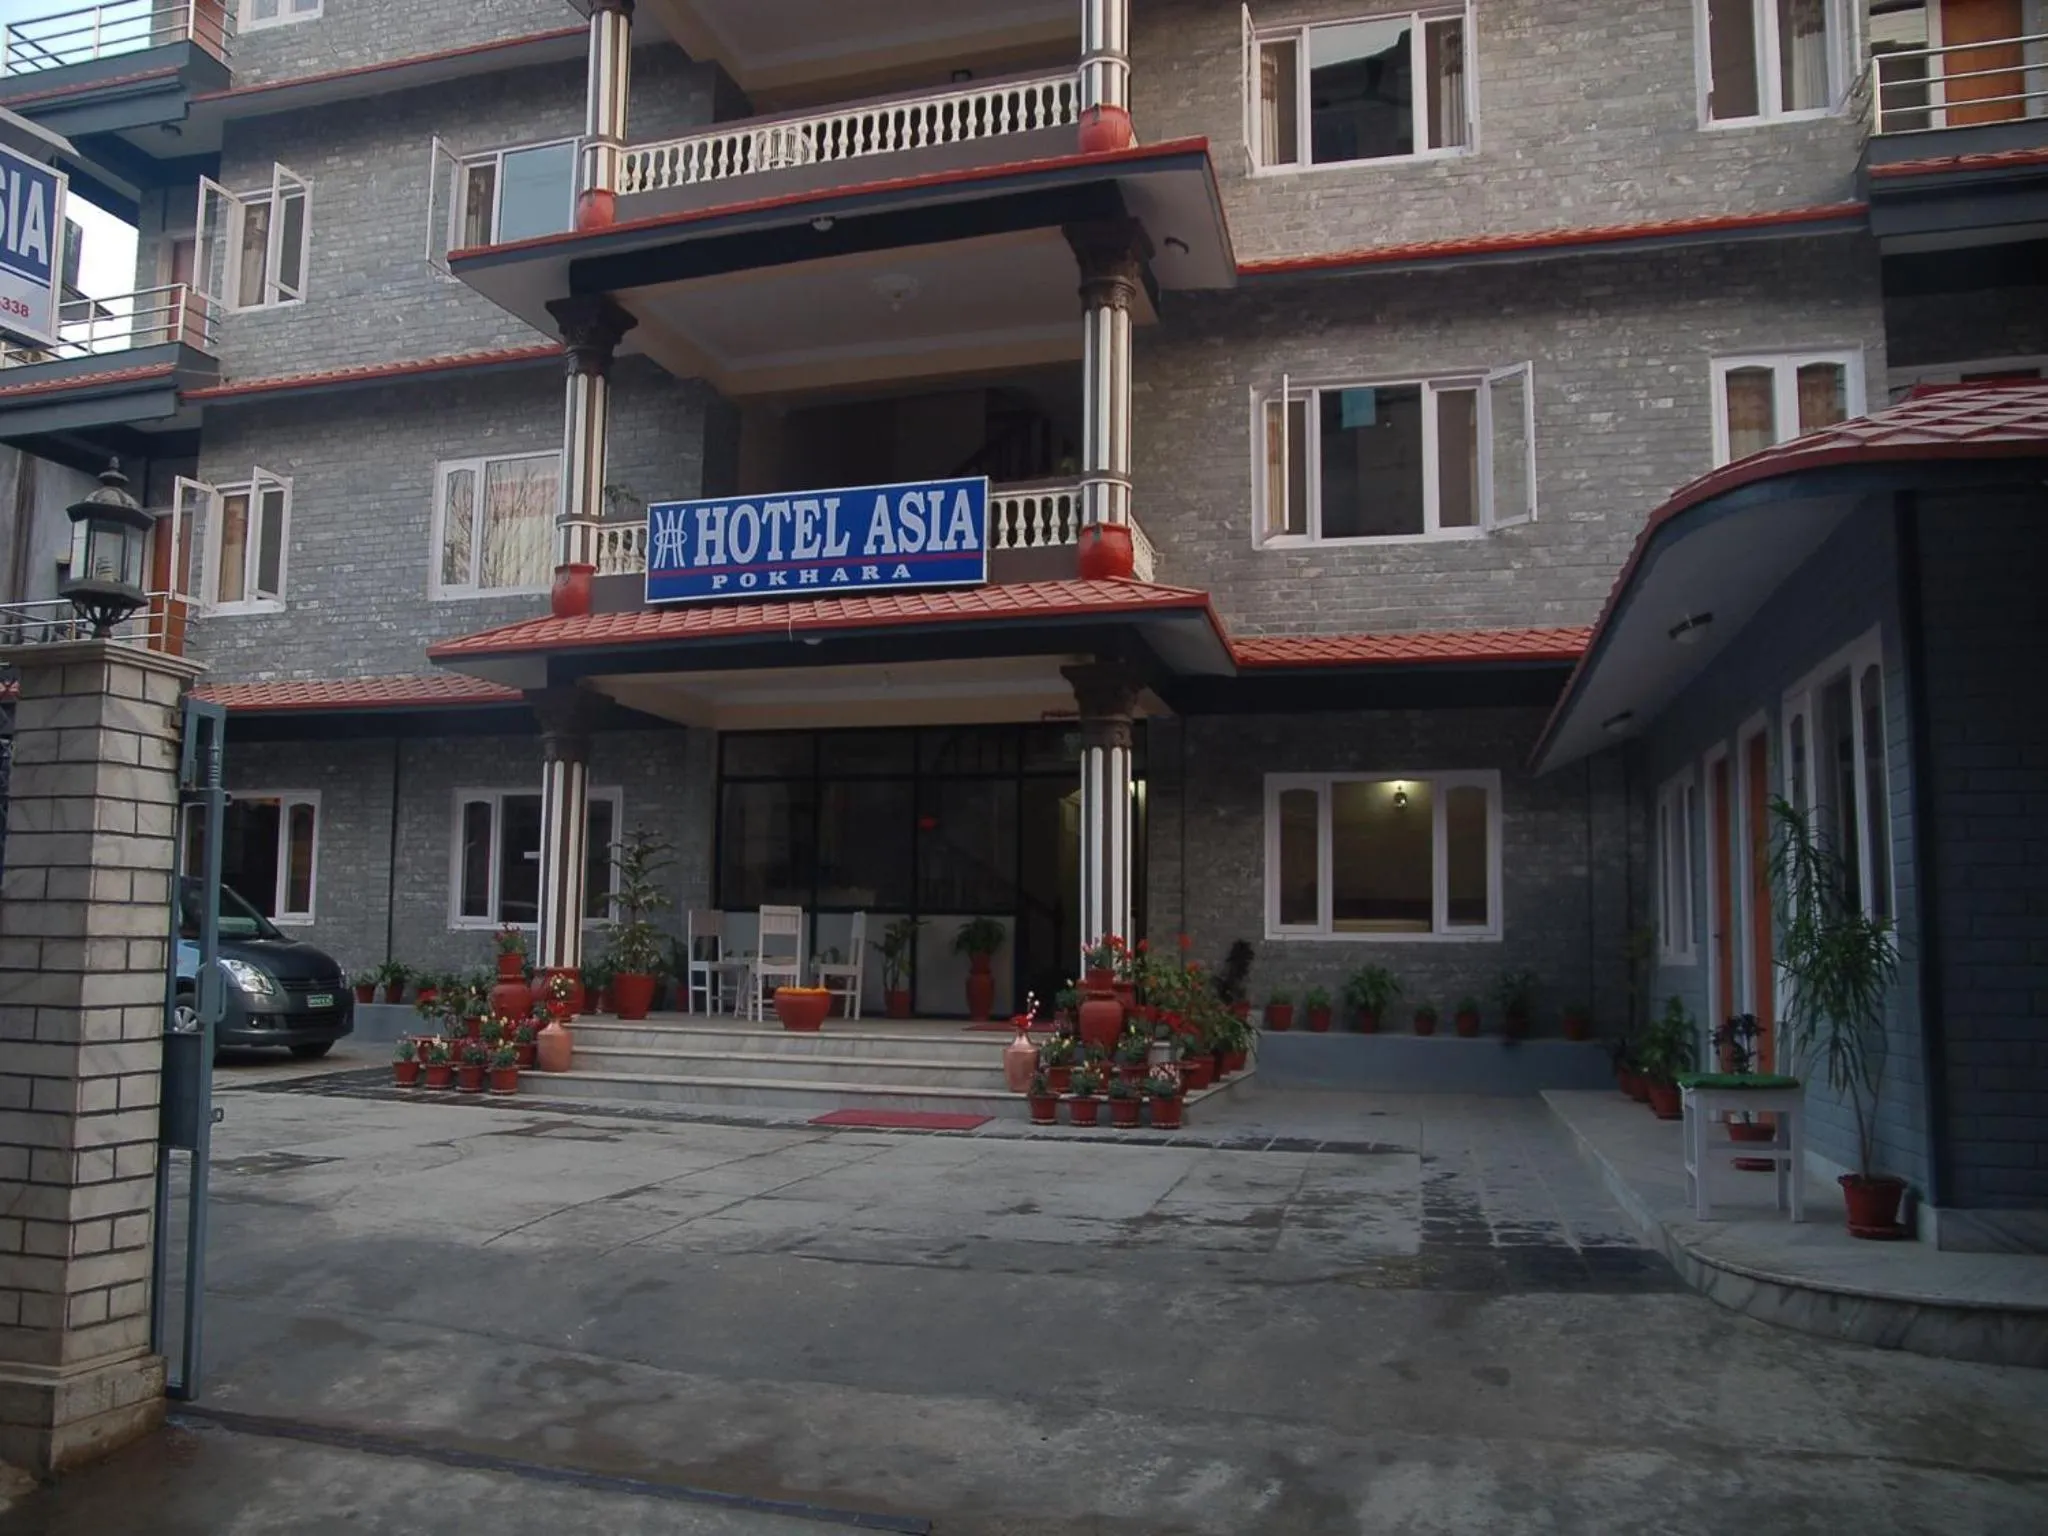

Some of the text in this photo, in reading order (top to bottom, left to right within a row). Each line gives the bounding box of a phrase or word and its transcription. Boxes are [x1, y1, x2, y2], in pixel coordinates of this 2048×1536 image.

[694, 498, 850, 566] HOTEL
[863, 489, 978, 555] ASIA
[711, 563, 911, 589] POKHARA
